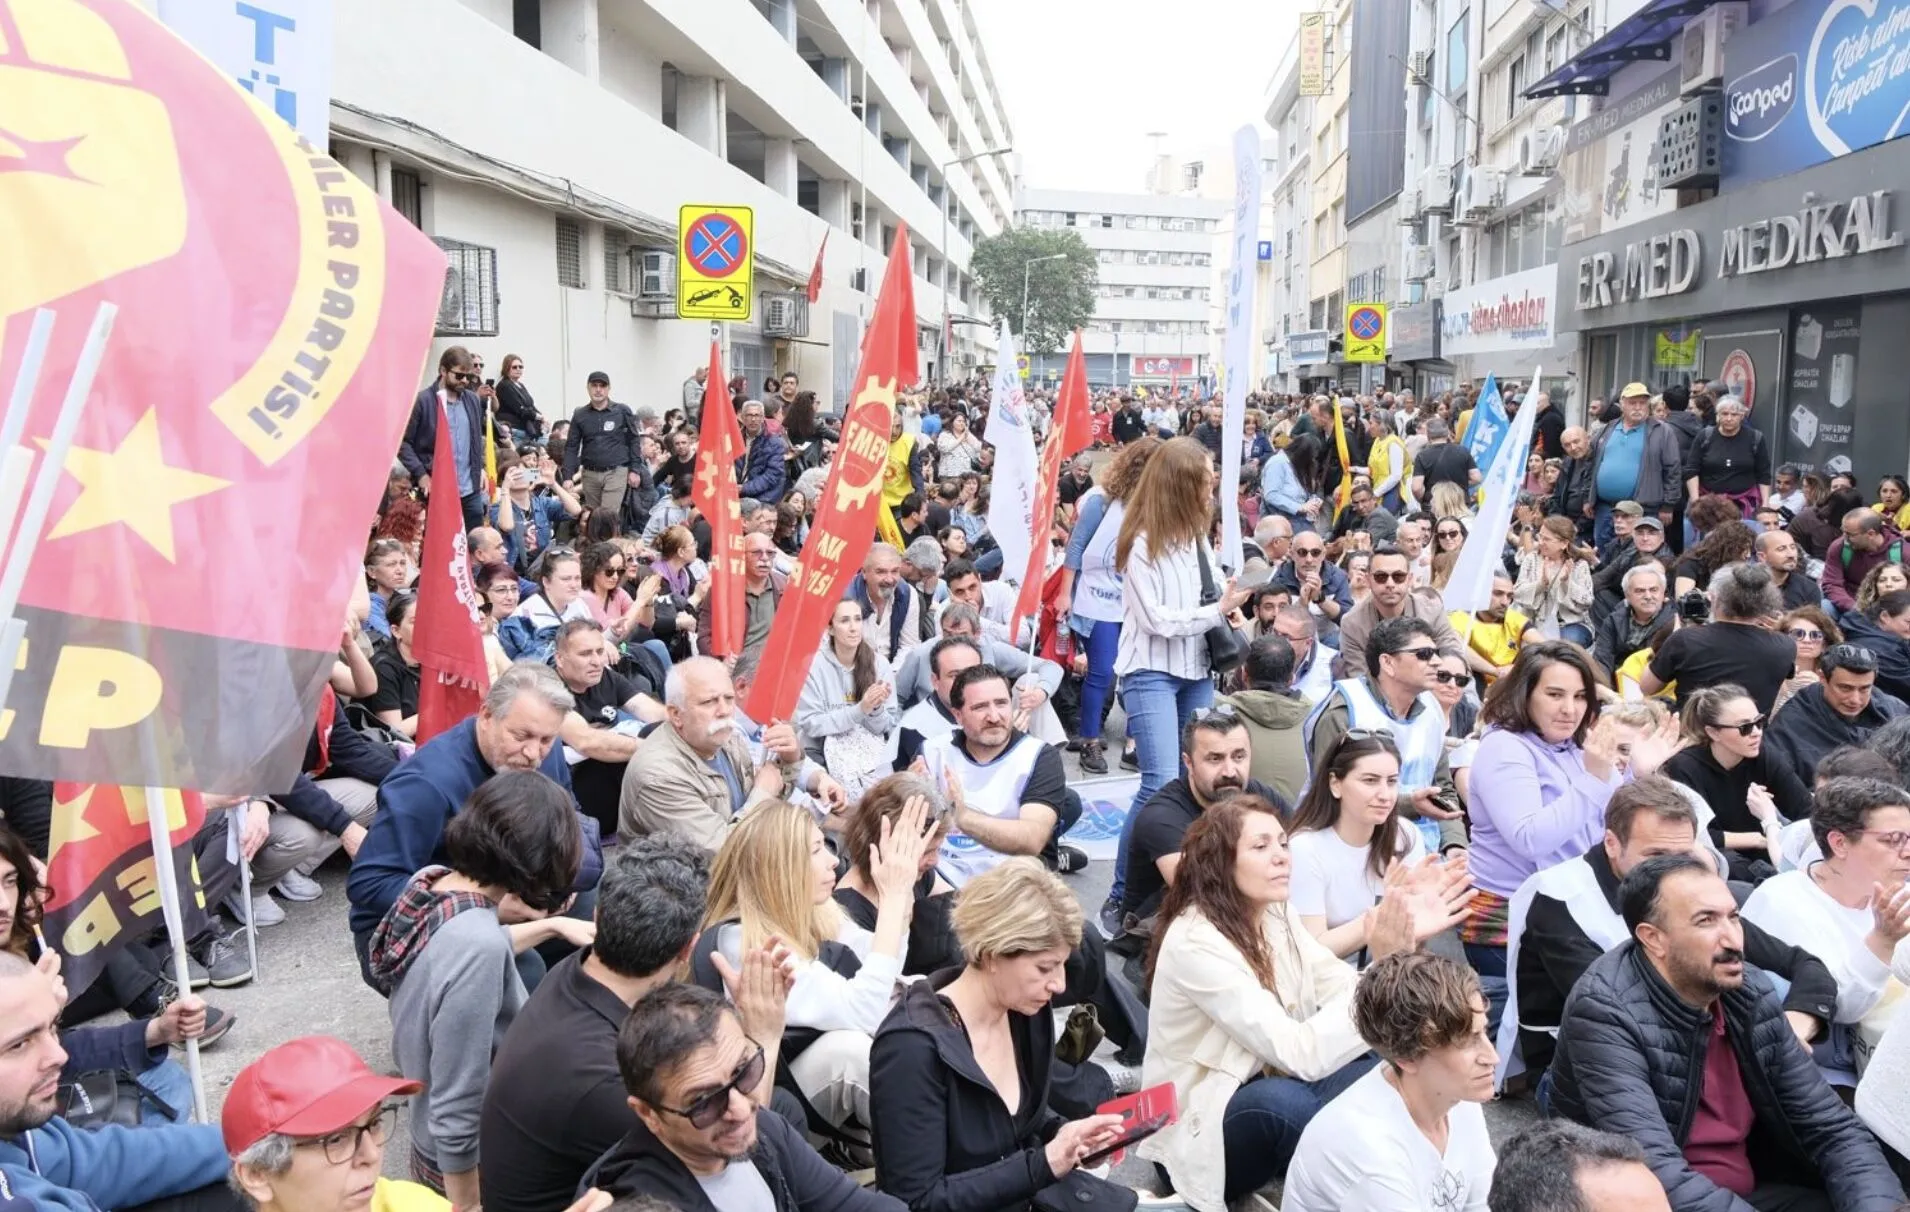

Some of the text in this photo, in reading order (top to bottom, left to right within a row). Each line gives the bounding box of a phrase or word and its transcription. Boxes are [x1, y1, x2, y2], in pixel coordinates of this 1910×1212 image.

[1575, 190, 1904, 311] ER-MED MEDİKAL
[247, 259, 360, 440] PARTİSİ
[846, 419, 889, 465] EMEP
